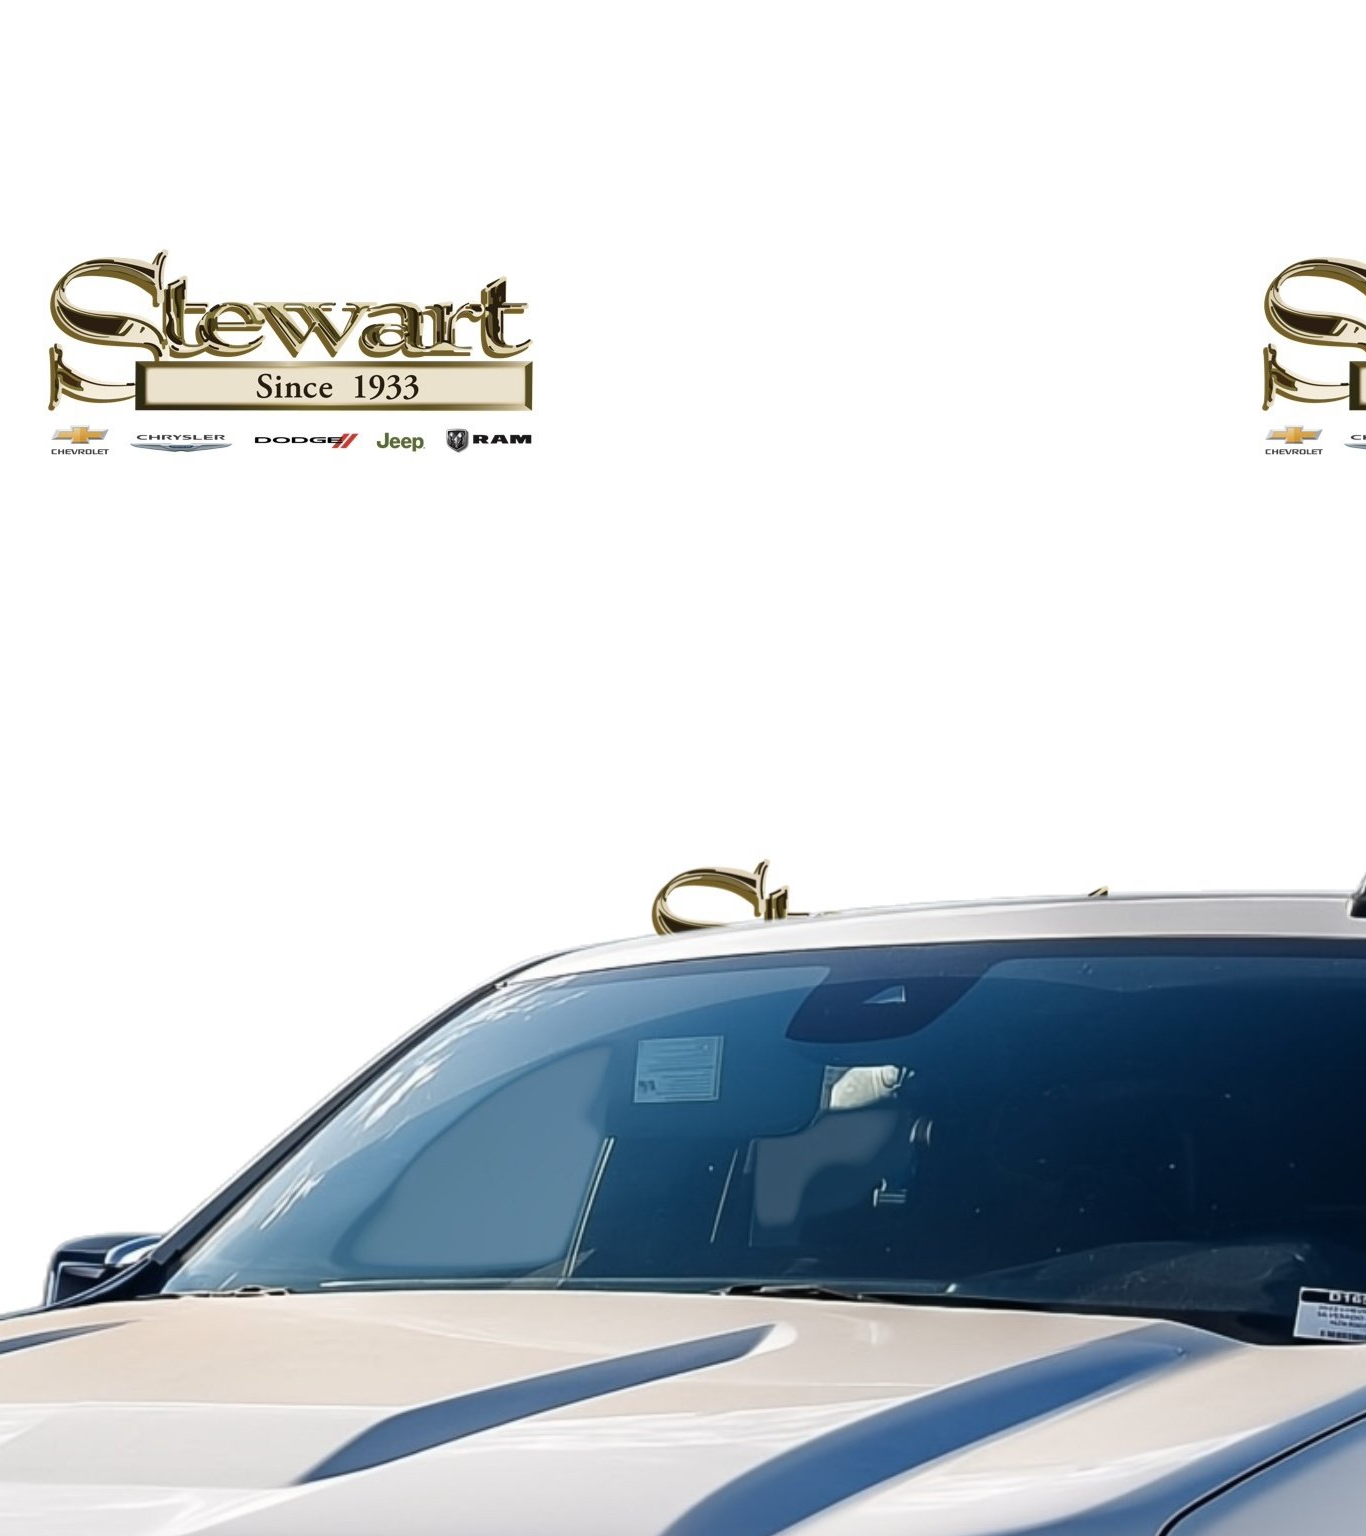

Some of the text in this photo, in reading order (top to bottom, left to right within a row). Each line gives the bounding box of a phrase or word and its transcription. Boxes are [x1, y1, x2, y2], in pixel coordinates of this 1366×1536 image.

[48, 248, 533, 411] Stewart
[256, 373, 420, 400] Since 1933
[50, 432, 533, 456] CHEVROLET CHRYSLER DODGE Jeep RAM
[1264, 448, 1324, 456] CHEVROLET
